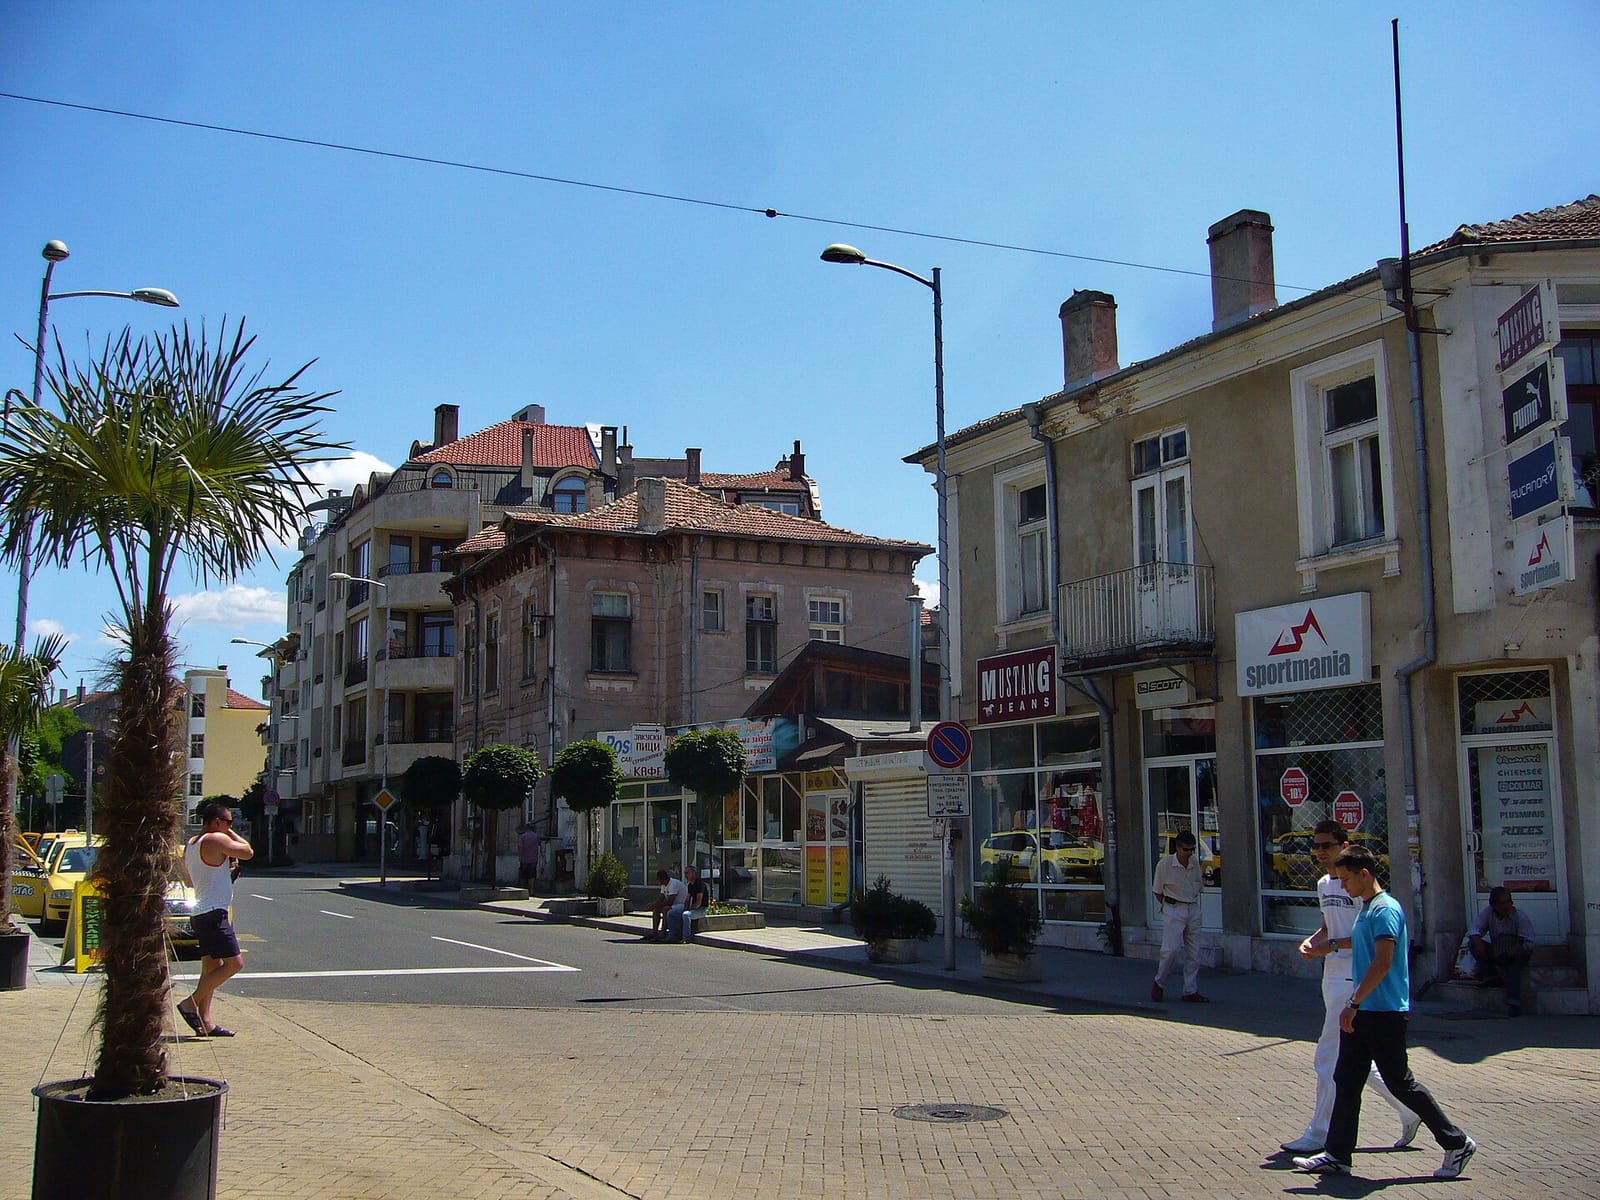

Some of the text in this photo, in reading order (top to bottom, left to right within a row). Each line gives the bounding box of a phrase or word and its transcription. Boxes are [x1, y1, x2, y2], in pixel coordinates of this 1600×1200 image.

[1512, 329, 1542, 359] JEANS
[1512, 398, 1538, 433] PUMA
[1511, 474, 1548, 500] RUCANOR
[1520, 560, 1560, 590] sportmania
[1246, 650, 1351, 689] sportmania
[981, 660, 1050, 702] MUSTANG
[1149, 677, 1183, 692] SCOTT
[999, 697, 1050, 714] JEANS
[636, 742, 660, 753] ПИЦИ
[1287, 787, 1303, 799] -10%
[1508, 782, 1542, 792] COLMAR
[1340, 811, 1358, 824] -20%
[1501, 825, 1544, 836] ROCES
[1515, 865, 1547, 875] killtec
